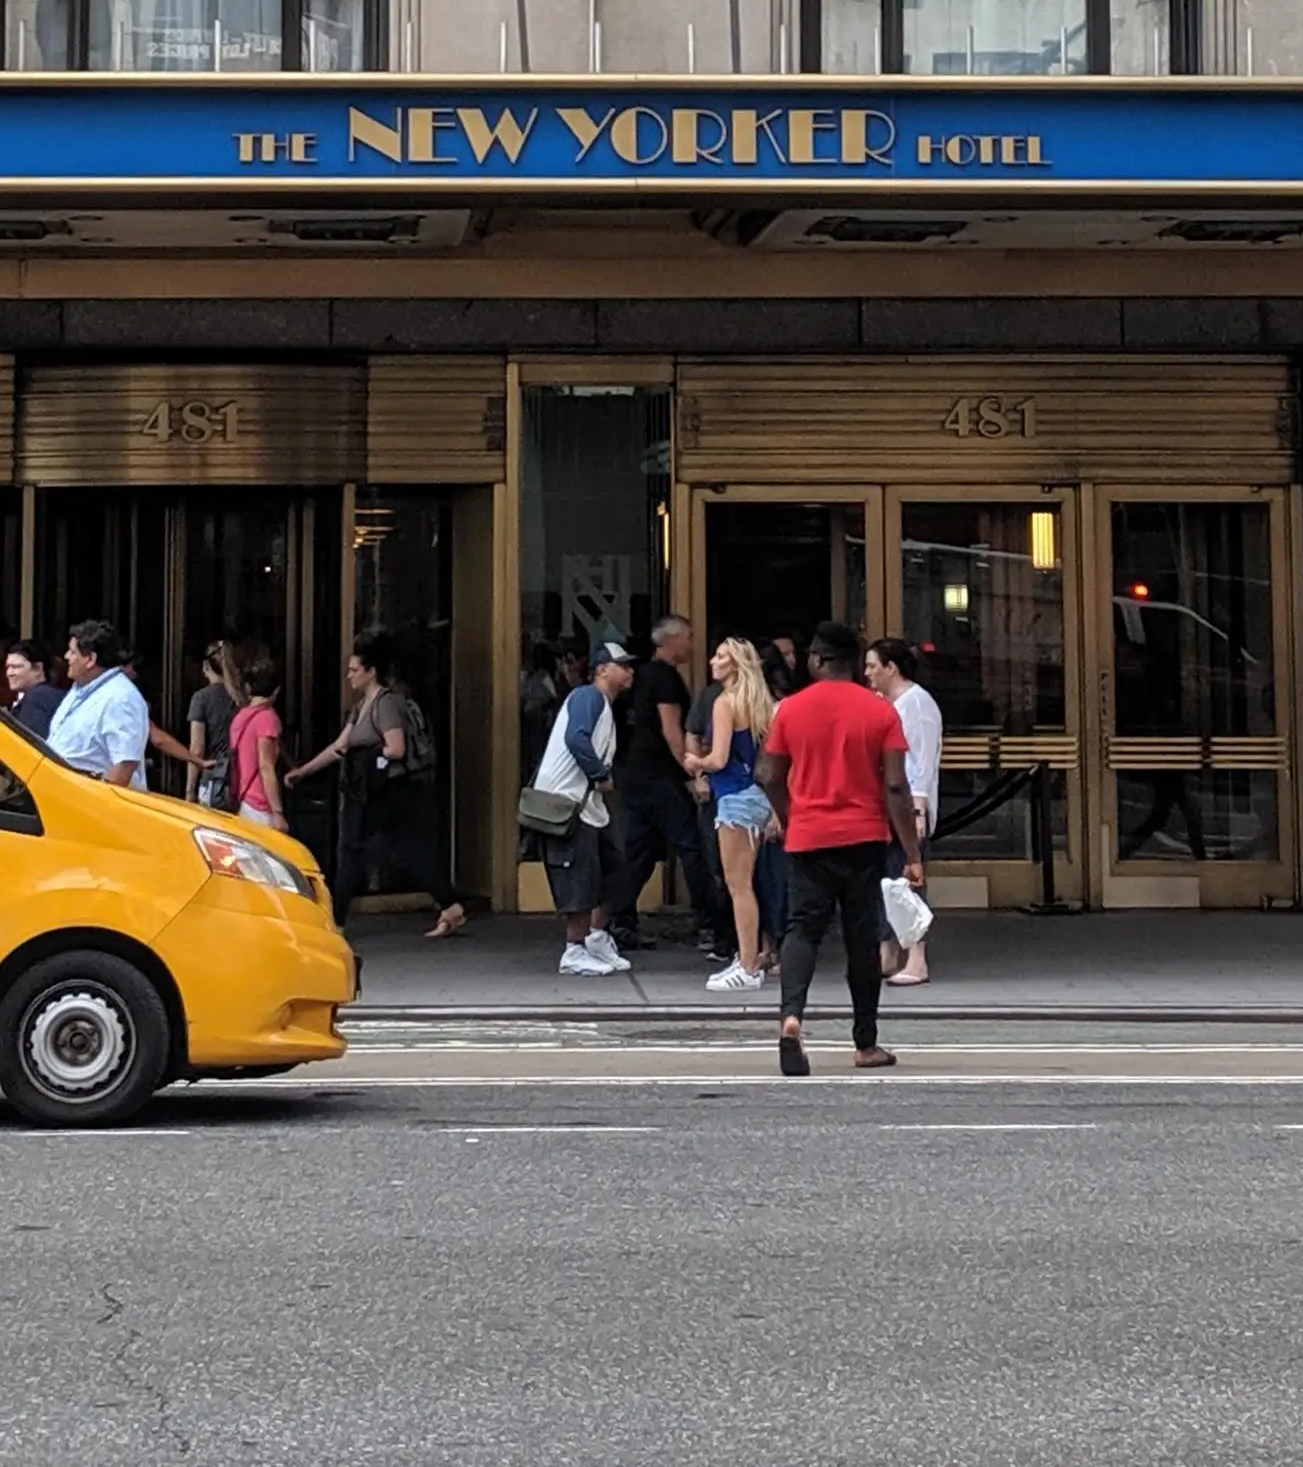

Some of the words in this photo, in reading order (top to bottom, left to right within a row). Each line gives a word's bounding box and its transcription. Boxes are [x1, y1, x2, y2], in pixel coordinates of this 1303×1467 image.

[233, 133, 319, 163] THE
[348, 106, 539, 165] NEW
[555, 106, 896, 166] YORKER
[917, 135, 1054, 166] HOTEL
[143, 400, 238, 443] 481
[943, 397, 1036, 439] 481
